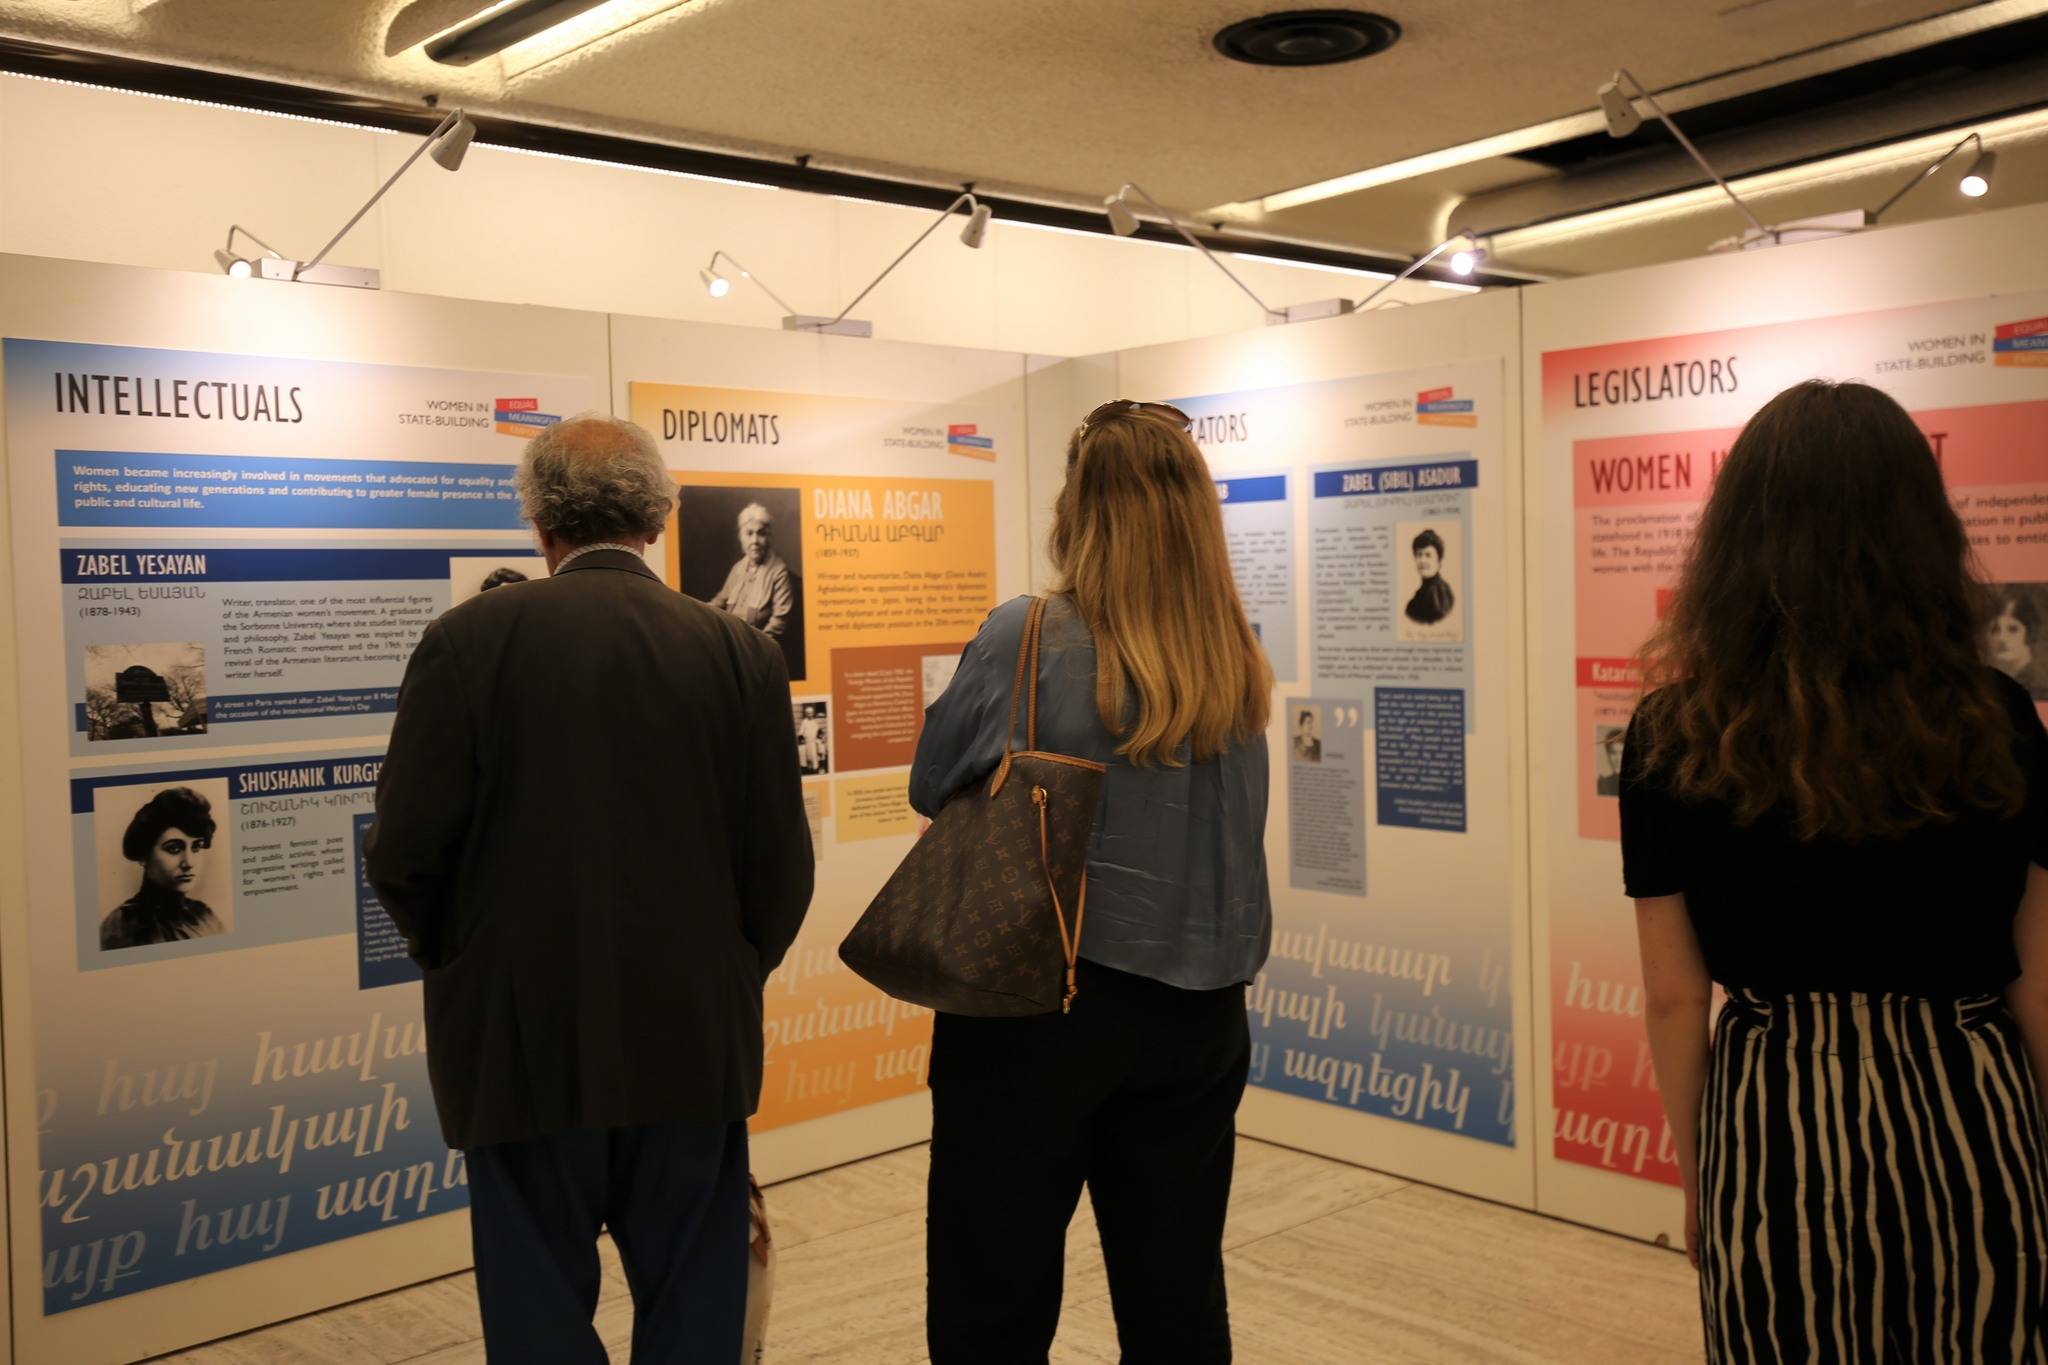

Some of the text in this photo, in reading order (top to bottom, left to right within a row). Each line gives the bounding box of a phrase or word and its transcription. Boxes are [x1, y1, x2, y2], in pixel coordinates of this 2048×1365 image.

[1908, 333, 1986, 352] WOMEN IN
[1875, 350, 1986, 374] STATE-BUILDING
[1574, 356, 1739, 409] LEGISLATORS
[54, 371, 303, 425] INTELLECTUALS
[427, 400, 489, 413] WOMEN IN
[399, 414, 489, 428] STATE-BUILDING
[662, 408, 781, 446] DIPLOMATS
[73, 465, 516, 489] Women became increasingly involved in movements that advocated for equality and
[1342, 473, 1375, 493] ZABEL
[1418, 466, 1461, 487] ASADUR
[1590, 453, 1692, 494] WOMEN
[74, 480, 512, 503] rights, educating new generations and contributing to greater female presence in the
[74, 497, 205, 511] public and cultural life.
[814, 488, 944, 520] DIANA ABGAR
[76, 553, 207, 576] ZABEL YESAYAN
[78, 585, 206, 601] ԶԱԲԵԼ ԵՍԱՅԱՆ
[318, 596, 328, 605] of
[330, 596, 343, 604] the
[346, 595, 366, 604] most
[369, 595, 405, 604] influential
[408, 594, 433, 605] figures
[79, 606, 141, 618] (1878-1943)
[222, 610, 232, 619] of
[235, 609, 249, 618] the
[252, 609, 293, 618] Armenian
[297, 608, 332, 617] women's
[380, 606, 387, 615] A
[390, 606, 422, 617] graduate
[424, 605, 433, 614] of
[222, 618, 397, 631] the Sorbonne University, where she studied
[224, 634, 240, 643] and
[293, 632, 316, 641] Zabel
[321, 631, 351, 643] Yesayan
[375, 630, 404, 641] inspired
[408, 629, 418, 640] by
[224, 646, 253, 655] French
[258, 644, 297, 654] Romantic
[301, 643, 345, 652] movement
[348, 642, 362, 651] and
[366, 641, 380, 650] the
[224, 657, 252, 667] revival
[254, 657, 264, 666] of
[265, 656, 280, 665] the
[282, 654, 321, 664] Armenian
[364, 651, 401, 663] becoming
[224, 669, 251, 678] writer
[239, 762, 383, 793] SHUSHANIK KURGH
[241, 816, 296, 832] (1876-1927)
[242, 843, 281, 852] Prominent
[290, 839, 318, 848] feminist
[242, 855, 256, 864] and
[261, 852, 284, 863] public
[321, 847, 344, 855] whose
[242, 856, 345, 876] progressive writings called
[304, 870, 324, 880] rights
[332, 867, 345, 876] and
[1283, 1047, 1471, 1130] ազդեցիկ
